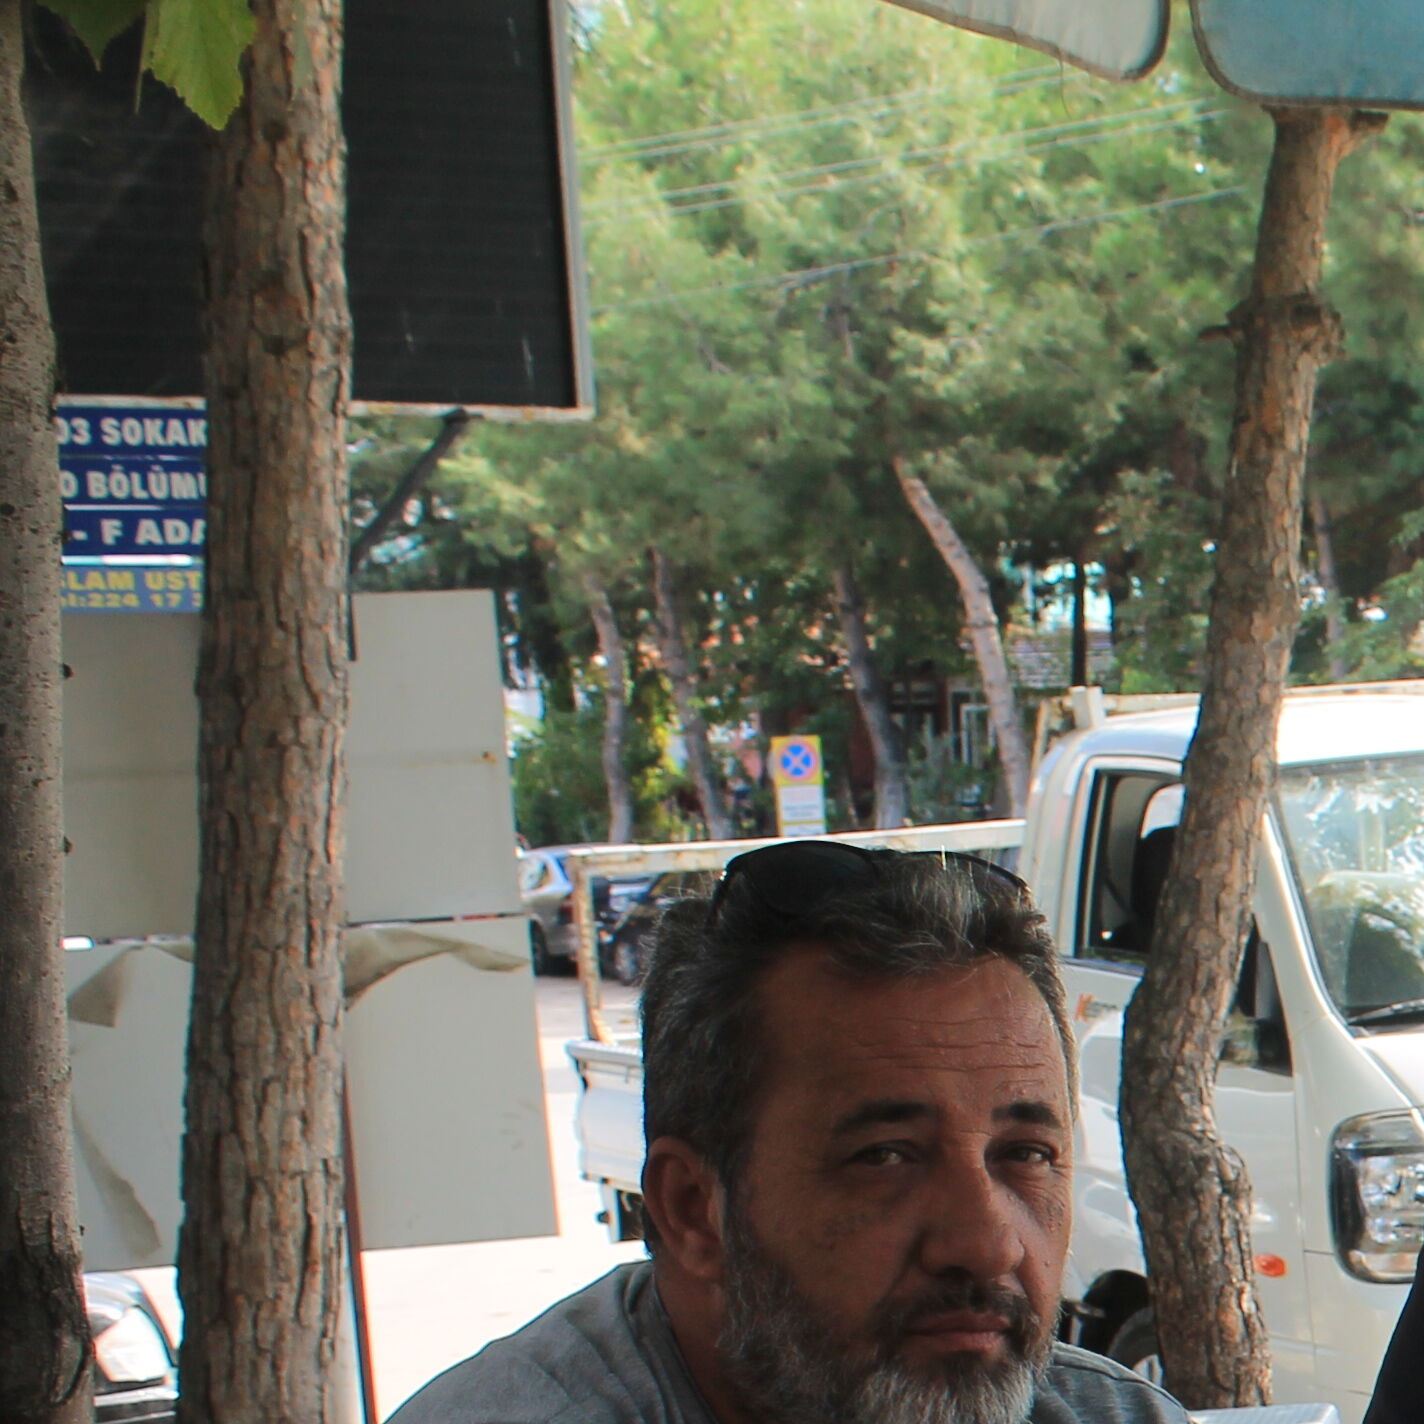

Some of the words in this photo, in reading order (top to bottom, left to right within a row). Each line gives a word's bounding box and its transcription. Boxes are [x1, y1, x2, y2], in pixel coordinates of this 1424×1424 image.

[100, 417, 207, 446] SOKAK
[100, 519, 123, 545] F
[61, 571, 135, 590] LAM
